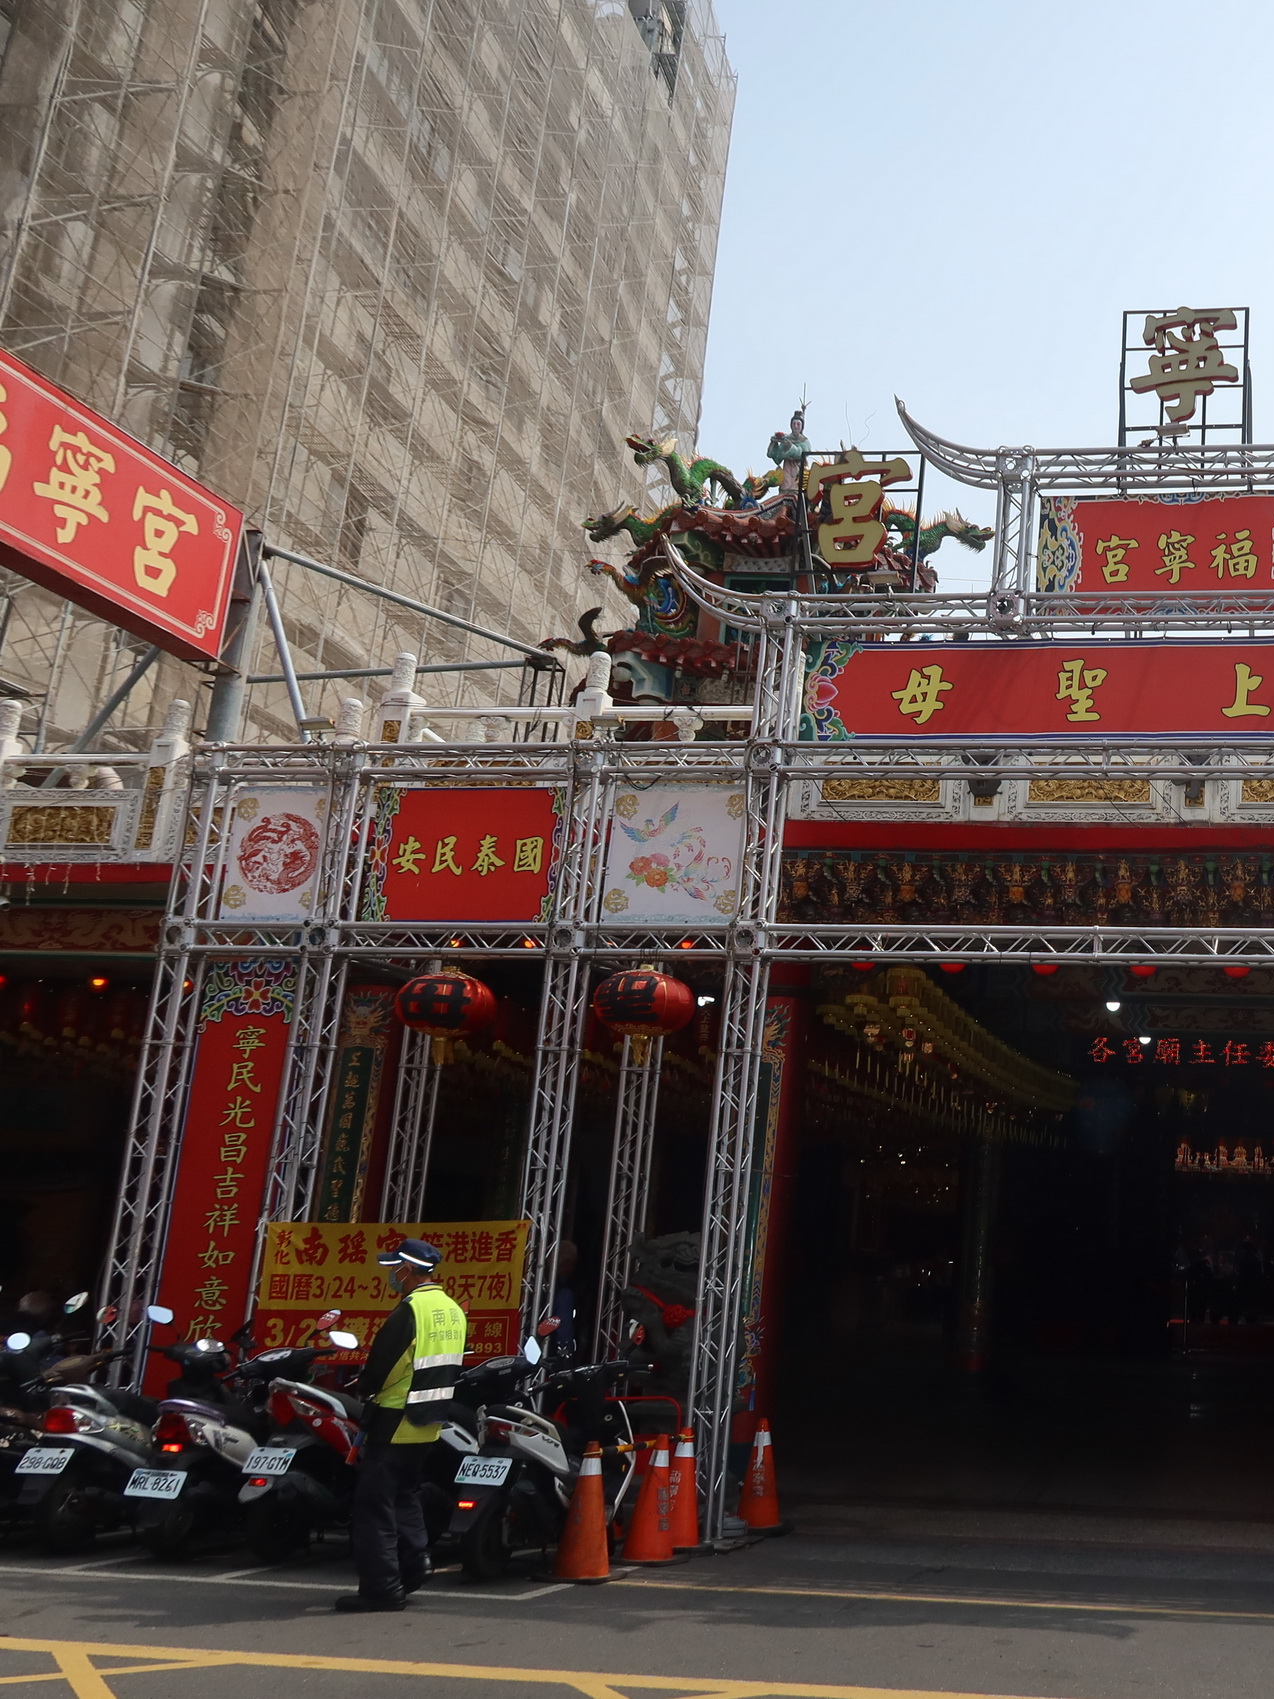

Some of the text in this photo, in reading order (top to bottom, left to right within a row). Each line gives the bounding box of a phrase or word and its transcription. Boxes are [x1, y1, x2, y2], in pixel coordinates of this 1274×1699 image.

[1130, 307, 1239, 423] 寧
[807, 446, 912, 568] 宮
[1097, 529, 1259, 584] 福寧宮
[458, 1462, 507, 1480] NEQ-5537
